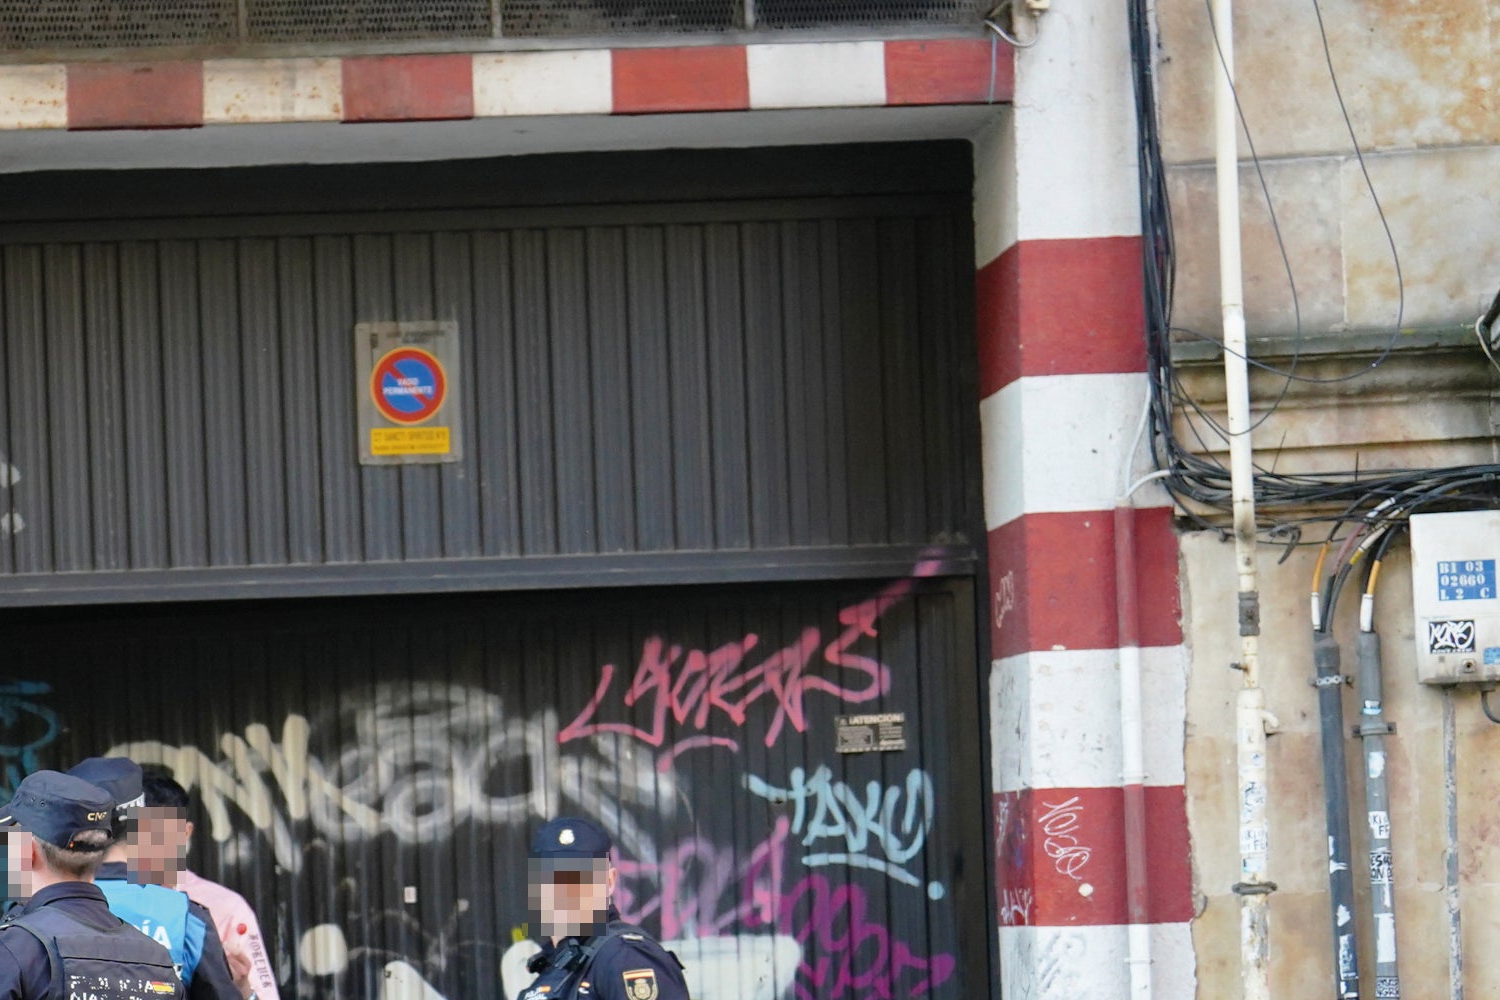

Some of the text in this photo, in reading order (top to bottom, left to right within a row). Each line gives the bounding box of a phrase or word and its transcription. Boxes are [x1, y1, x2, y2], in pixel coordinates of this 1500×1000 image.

[396, 377, 419, 386] VADO
[382, 385, 433, 395] PERMANENTE
[1465, 560, 1484, 573] 03
[1440, 573, 1485, 588] 02660
[1440, 586, 1490, 600] L 2 C
